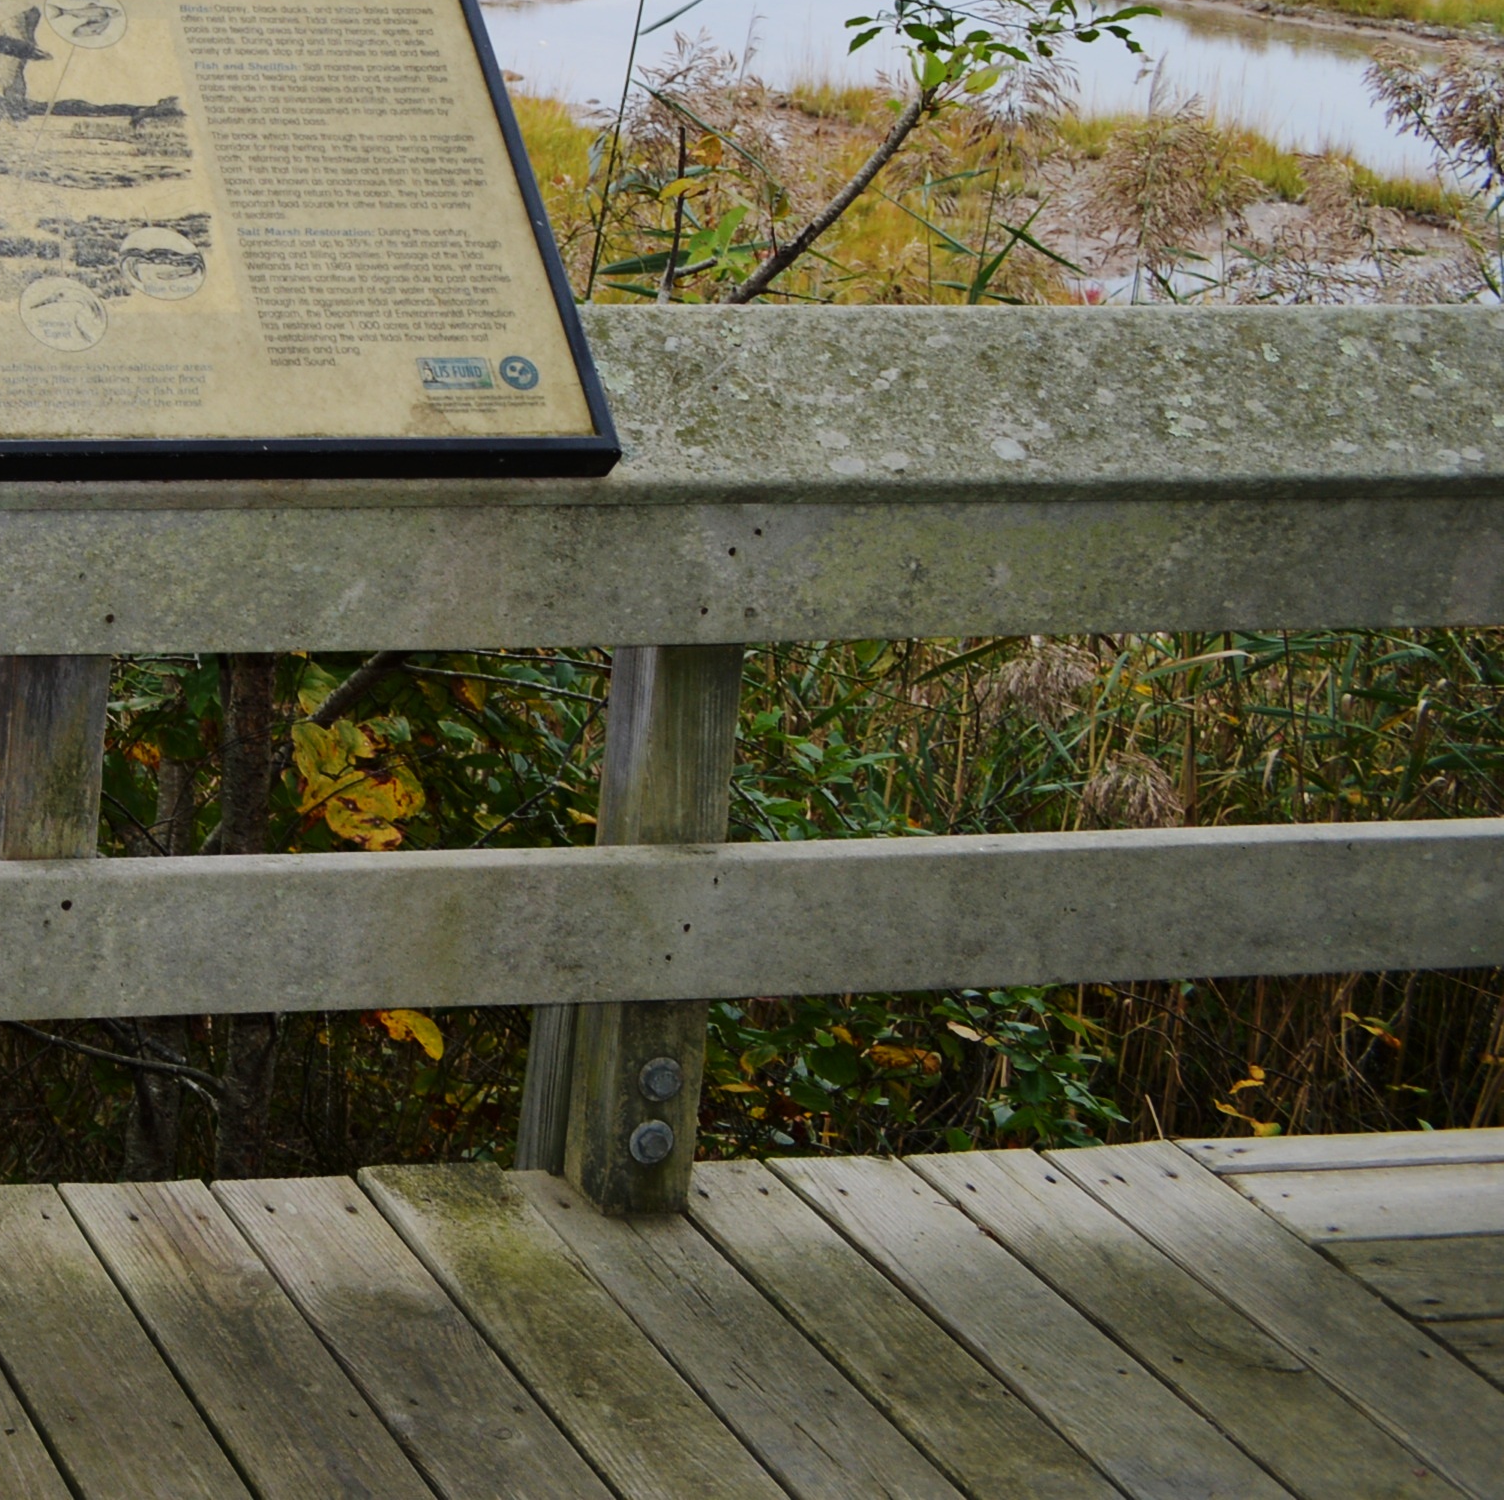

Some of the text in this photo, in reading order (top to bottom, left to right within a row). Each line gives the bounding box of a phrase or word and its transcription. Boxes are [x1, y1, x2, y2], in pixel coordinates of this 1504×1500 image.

[194, 61, 219, 70] Fish
[237, 227, 260, 236] Salt
[264, 227, 301, 236] Marsh
[305, 227, 375, 237] Restoration:
[433, 366, 482, 378] LIS FUND
